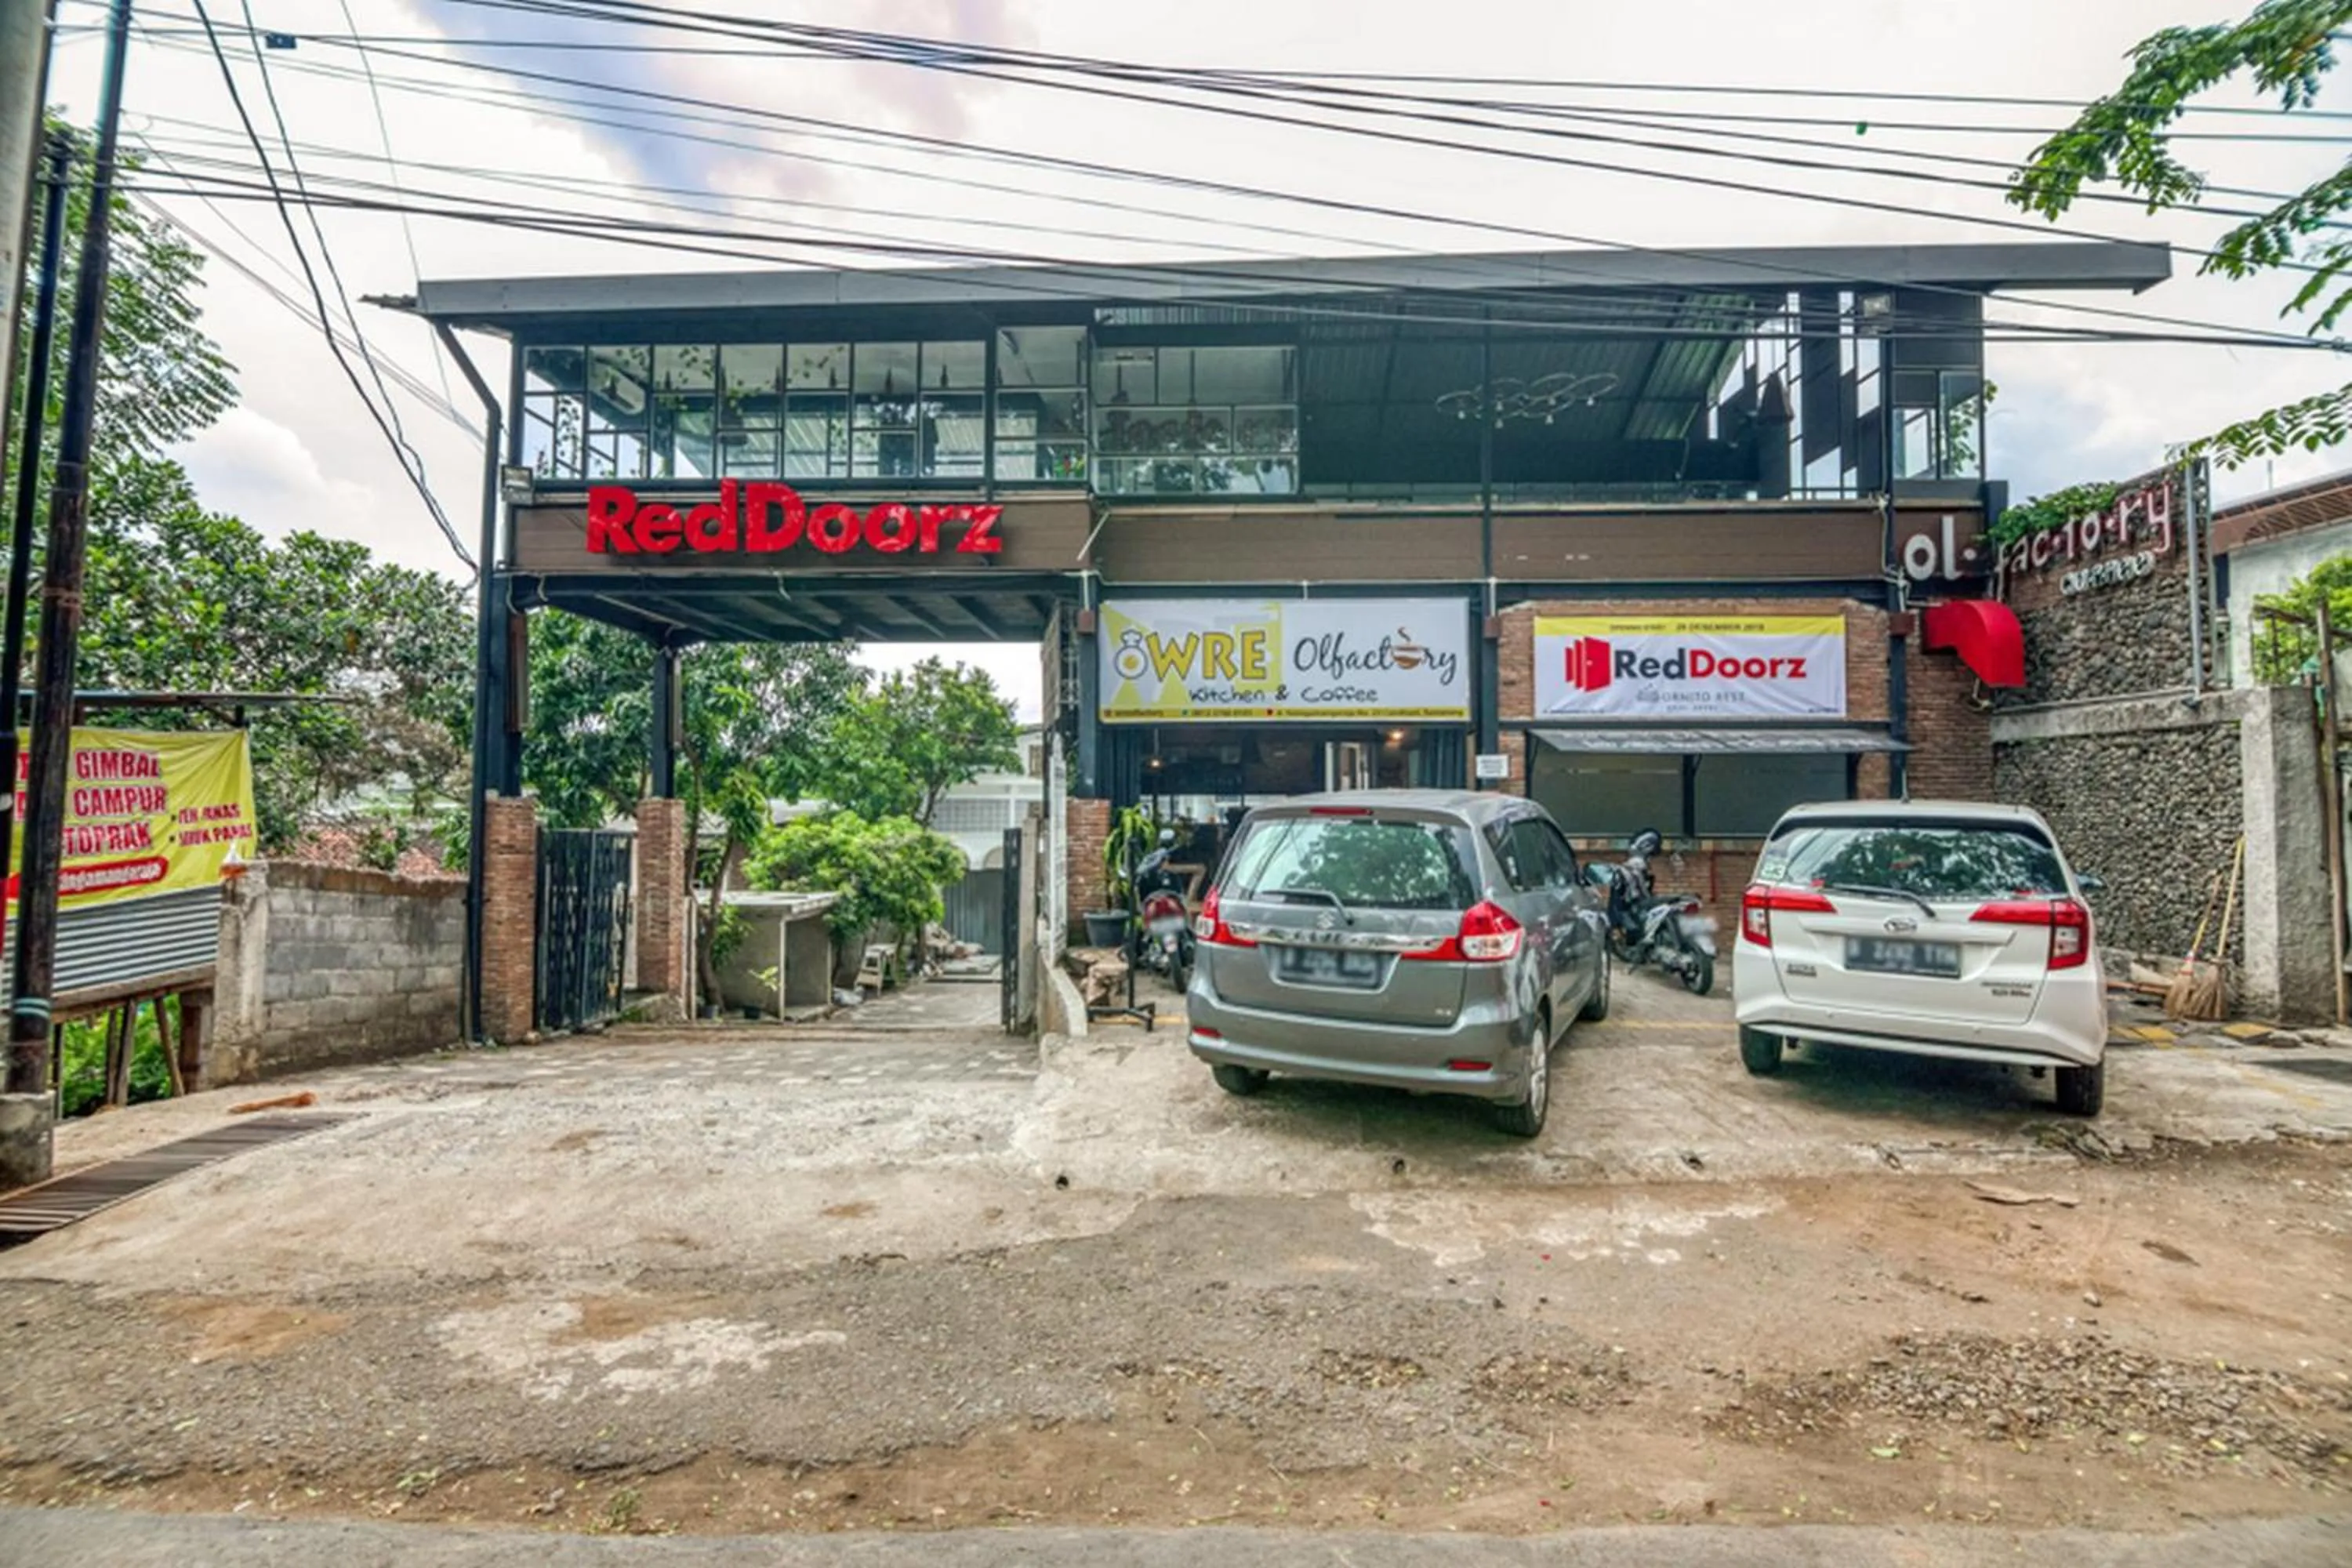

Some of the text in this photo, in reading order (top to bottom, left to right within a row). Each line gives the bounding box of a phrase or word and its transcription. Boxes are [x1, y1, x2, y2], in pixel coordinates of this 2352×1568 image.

[586, 477, 1004, 554] RedDoorz
[1614, 648, 1807, 680] RedDoorz
[73, 785, 168, 817] CAMPUR
